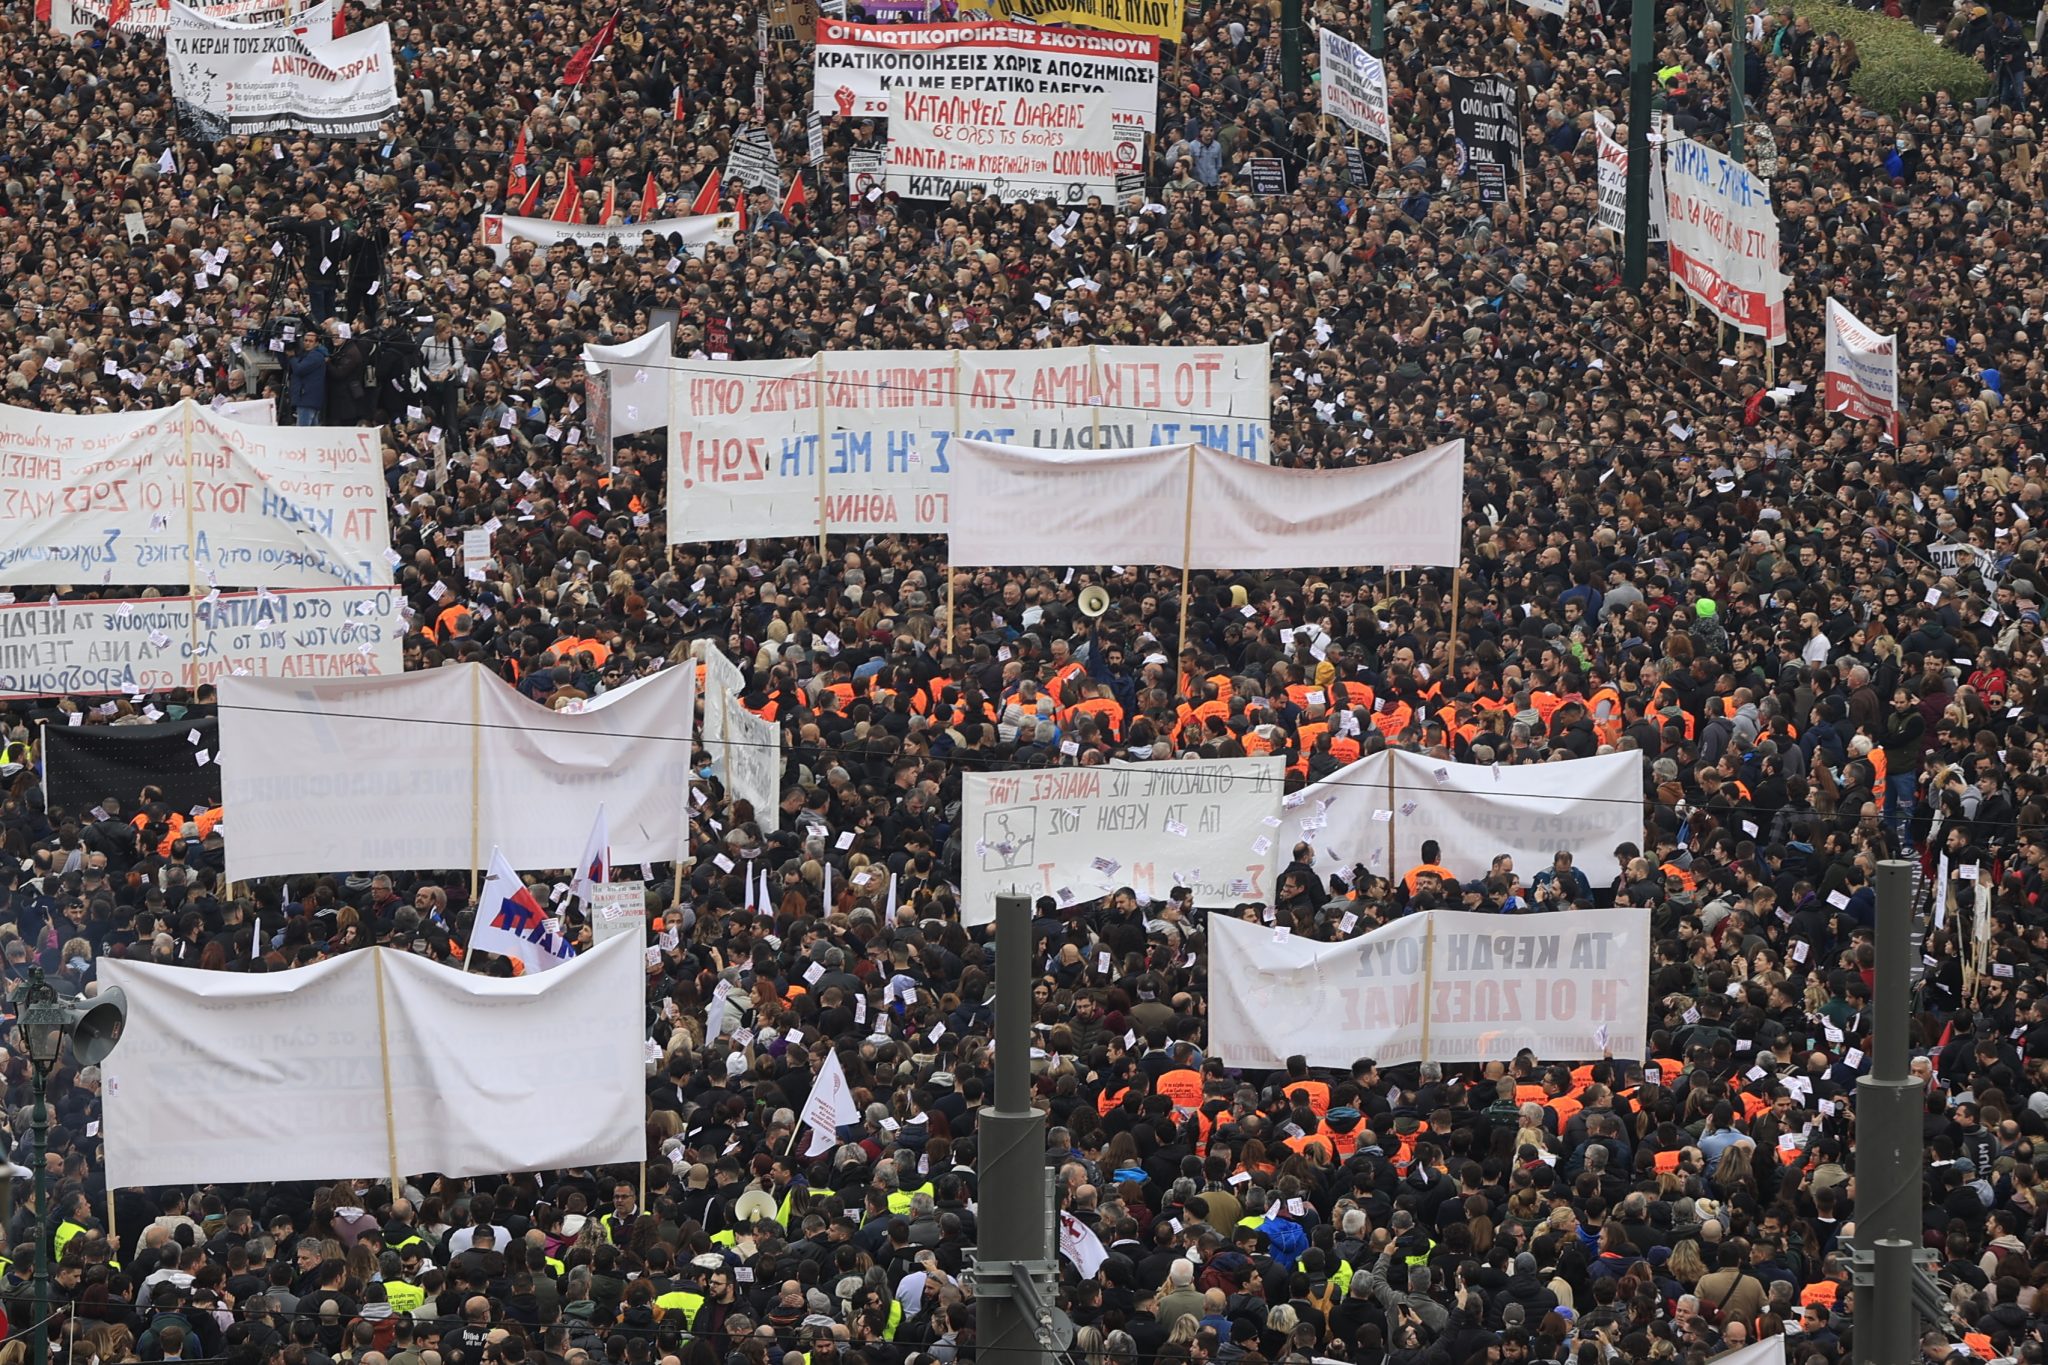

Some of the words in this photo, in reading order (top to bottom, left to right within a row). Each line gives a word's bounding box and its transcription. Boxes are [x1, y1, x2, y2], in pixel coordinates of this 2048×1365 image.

[175, 38, 188, 54] ΤΑ
[191, 37, 229, 54] ΚΕΡΔΗ
[233, 37, 260, 54] ΤΟΥΣ
[827, 25, 850, 40] ΟΙ
[855, 26, 1036, 46] ΙΔΙΩΤΙΚΟΠΟΙΗΣΕΙΣ
[1040, 32, 1152, 55] ΣΚΟΤΩΝΟΥΝ
[271, 56, 337, 82] ΑΝΑΤΡΟΠΗ
[338, 53, 380, 80] ΤΩΡΑ!
[818, 51, 987, 71] ΚΡΑΤΙΚΟΠΟΙΗΣΕΙΣ
[994, 55, 1042, 75] ΧΩΡΙΣ
[918, 76, 946, 90] ΜΕ
[950, 76, 1034, 93] ΕΡΓΑΤΙΚΟ
[904, 91, 1006, 127] ΚΑΤΑΛΗΨΕΙΣ
[1014, 97, 1085, 129] ΔΙΑΡΚΕΙΑΣ
[231, 119, 290, 135] ΠΡΩΤΟΒΑΘΜΙΑ
[950, 154, 976, 171] ΣΤΗΝ
[978, 153, 1030, 176] ΚΥΒΕΡΝΗΣΗ
